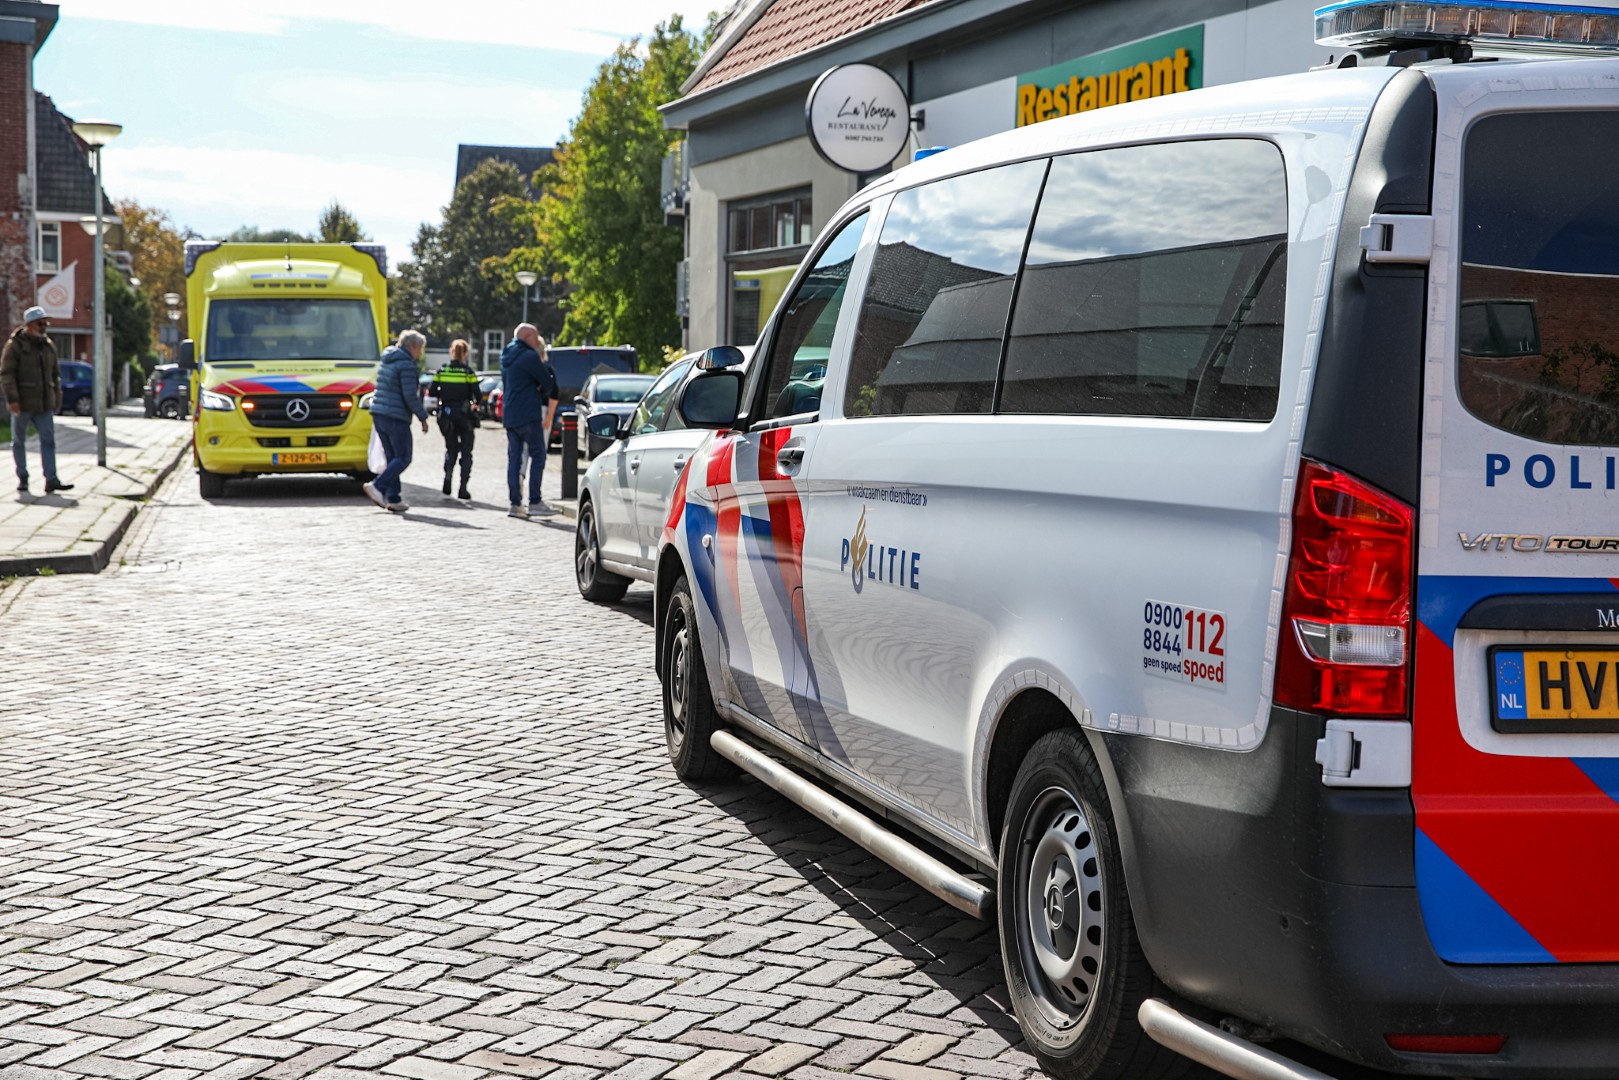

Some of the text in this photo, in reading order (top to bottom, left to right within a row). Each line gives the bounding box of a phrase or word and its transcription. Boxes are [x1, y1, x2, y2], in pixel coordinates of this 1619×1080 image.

[1017, 47, 1189, 129] Restaurant
[828, 122, 881, 131] RESTAURANT
[889, 485, 922, 506] dienstbaar
[1458, 532, 1545, 552] VITO
[840, 537, 921, 594] POLITIE
[1144, 602, 1182, 629] 0900
[1144, 628, 1181, 656] 8844
[1185, 610, 1224, 656] 112
[1143, 657, 1181, 673] geen spoed
[1183, 659, 1224, 683] spoed
[1538, 660, 1619, 710] HV
[1501, 693, 1523, 709] NL
